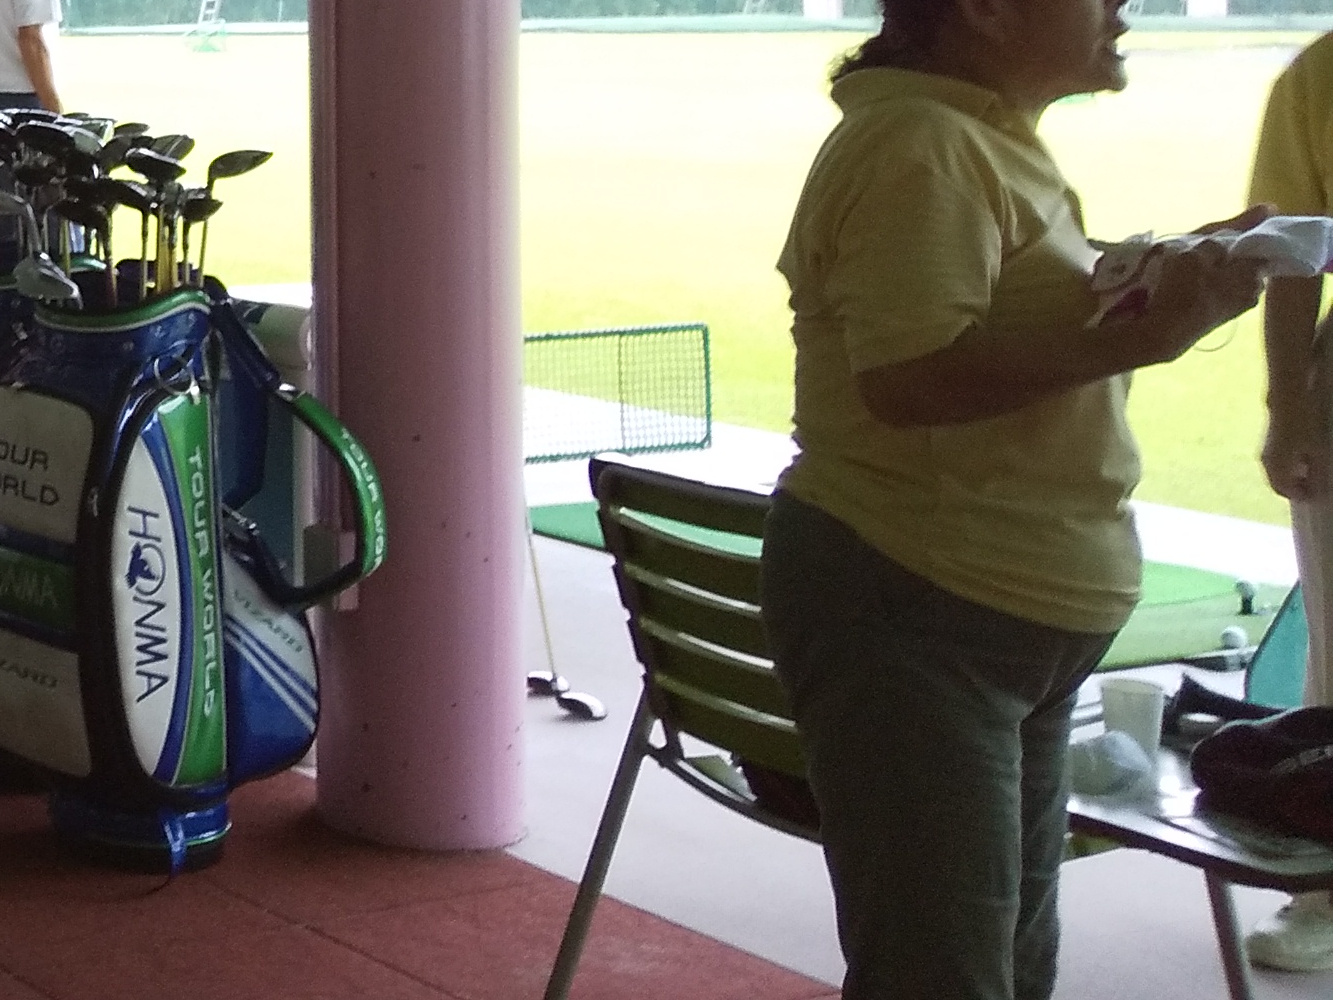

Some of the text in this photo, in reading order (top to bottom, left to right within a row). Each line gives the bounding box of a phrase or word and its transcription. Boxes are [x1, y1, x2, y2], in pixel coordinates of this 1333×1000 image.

[125, 504, 170, 704] HONMA
[188, 445, 219, 718] TOUR WORLD
